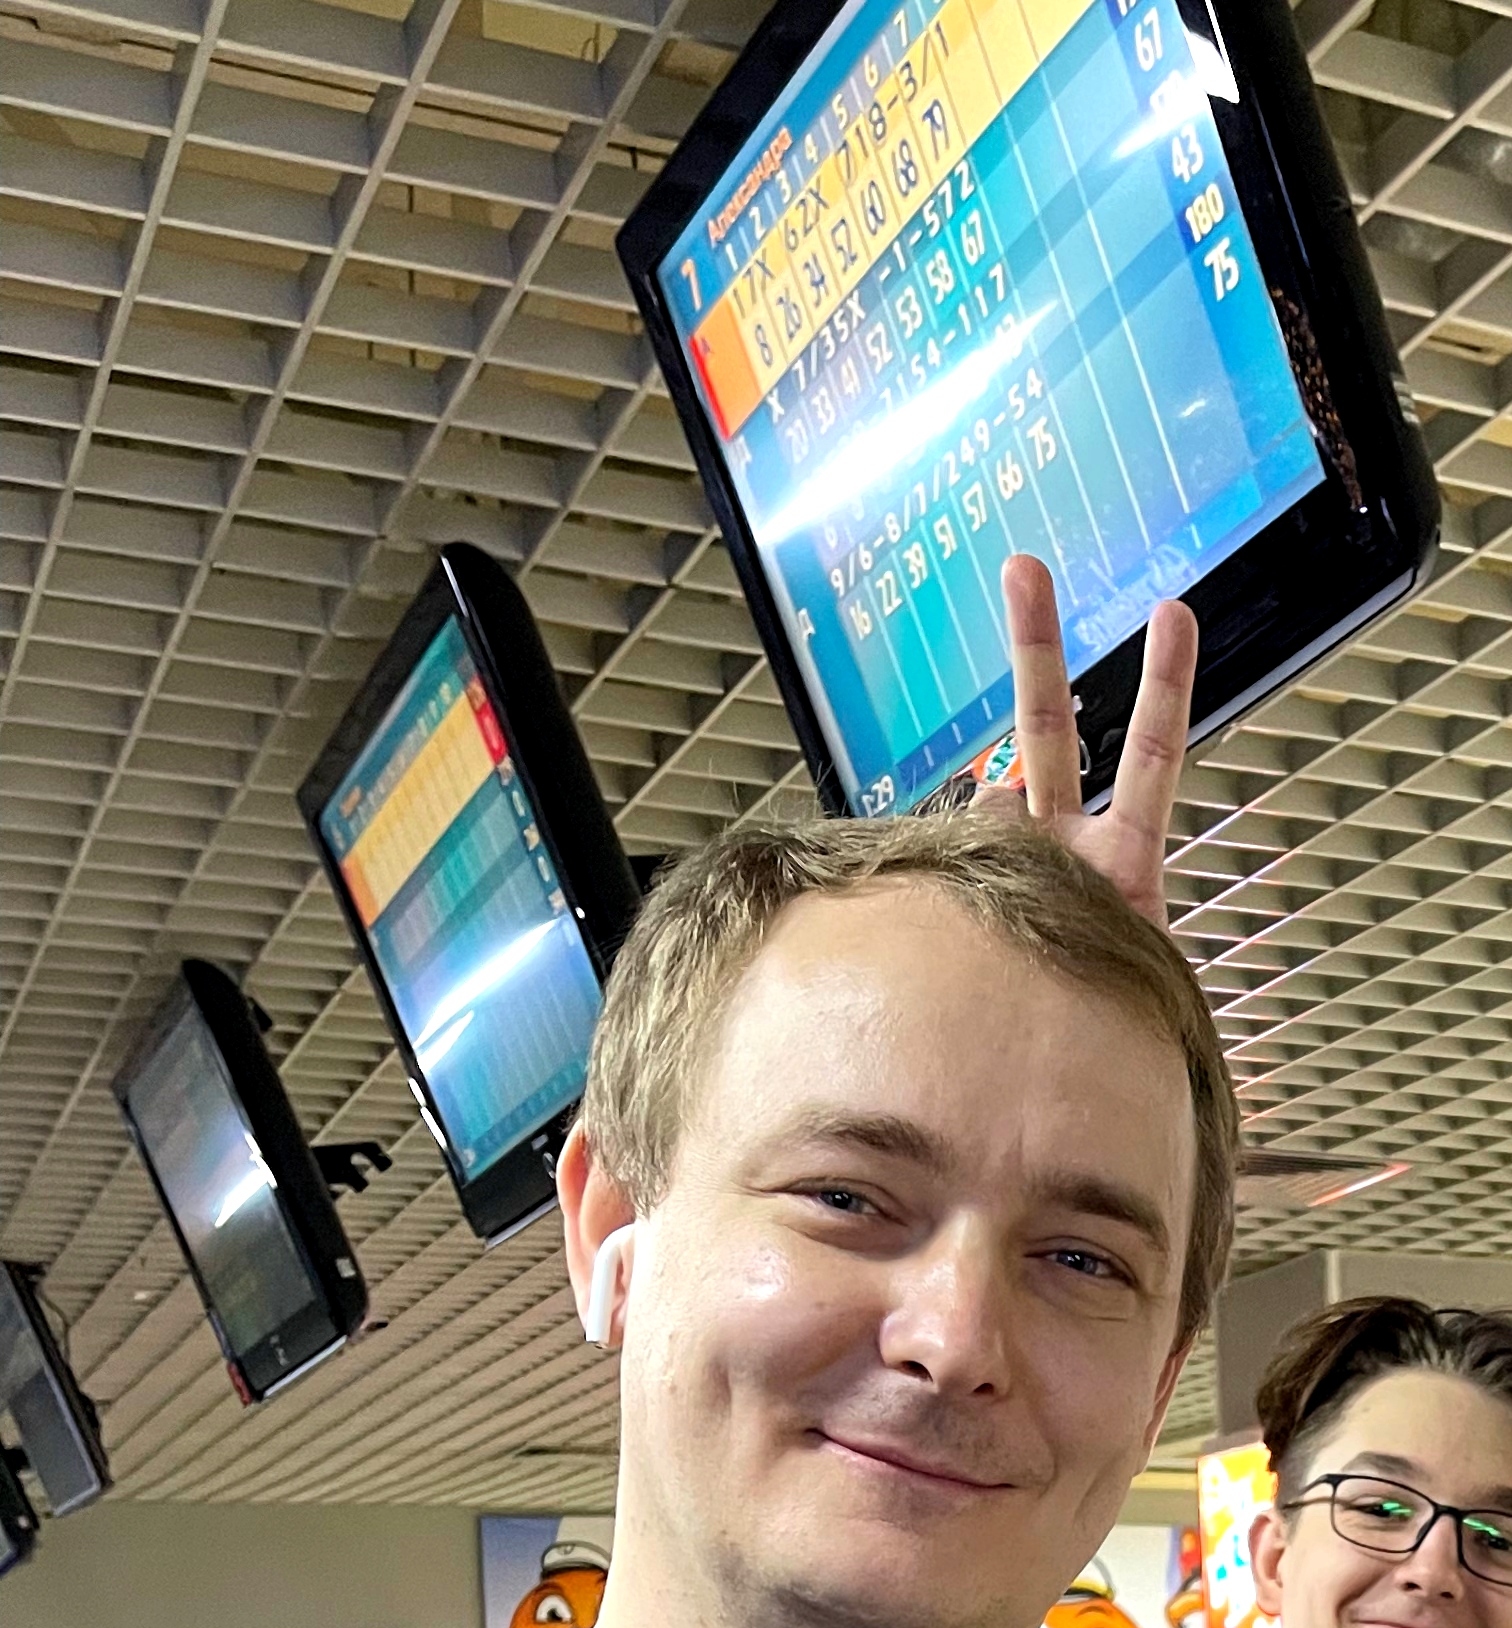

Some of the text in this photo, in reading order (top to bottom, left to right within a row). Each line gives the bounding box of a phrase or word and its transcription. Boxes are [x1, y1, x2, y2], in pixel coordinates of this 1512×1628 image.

[1134, 7, 1164, 72] 67
[725, 9, 909, 272] 1 2 3 4 5 6 7
[1171, 123, 1205, 184] 43
[755, 324, 772, 367] 8
[860, 180, 886, 236] 60
[892, 139, 918, 198] 68
[921, 98, 950, 162] 79
[1185, 182, 1225, 243] 180
[895, 285, 923, 339] 53
[926, 248, 956, 305] 58
[960, 209, 986, 266] 67
[1203, 237, 1240, 300] 75
[850, 416, 1057, 640] 16 22 39 51 57 66 75
